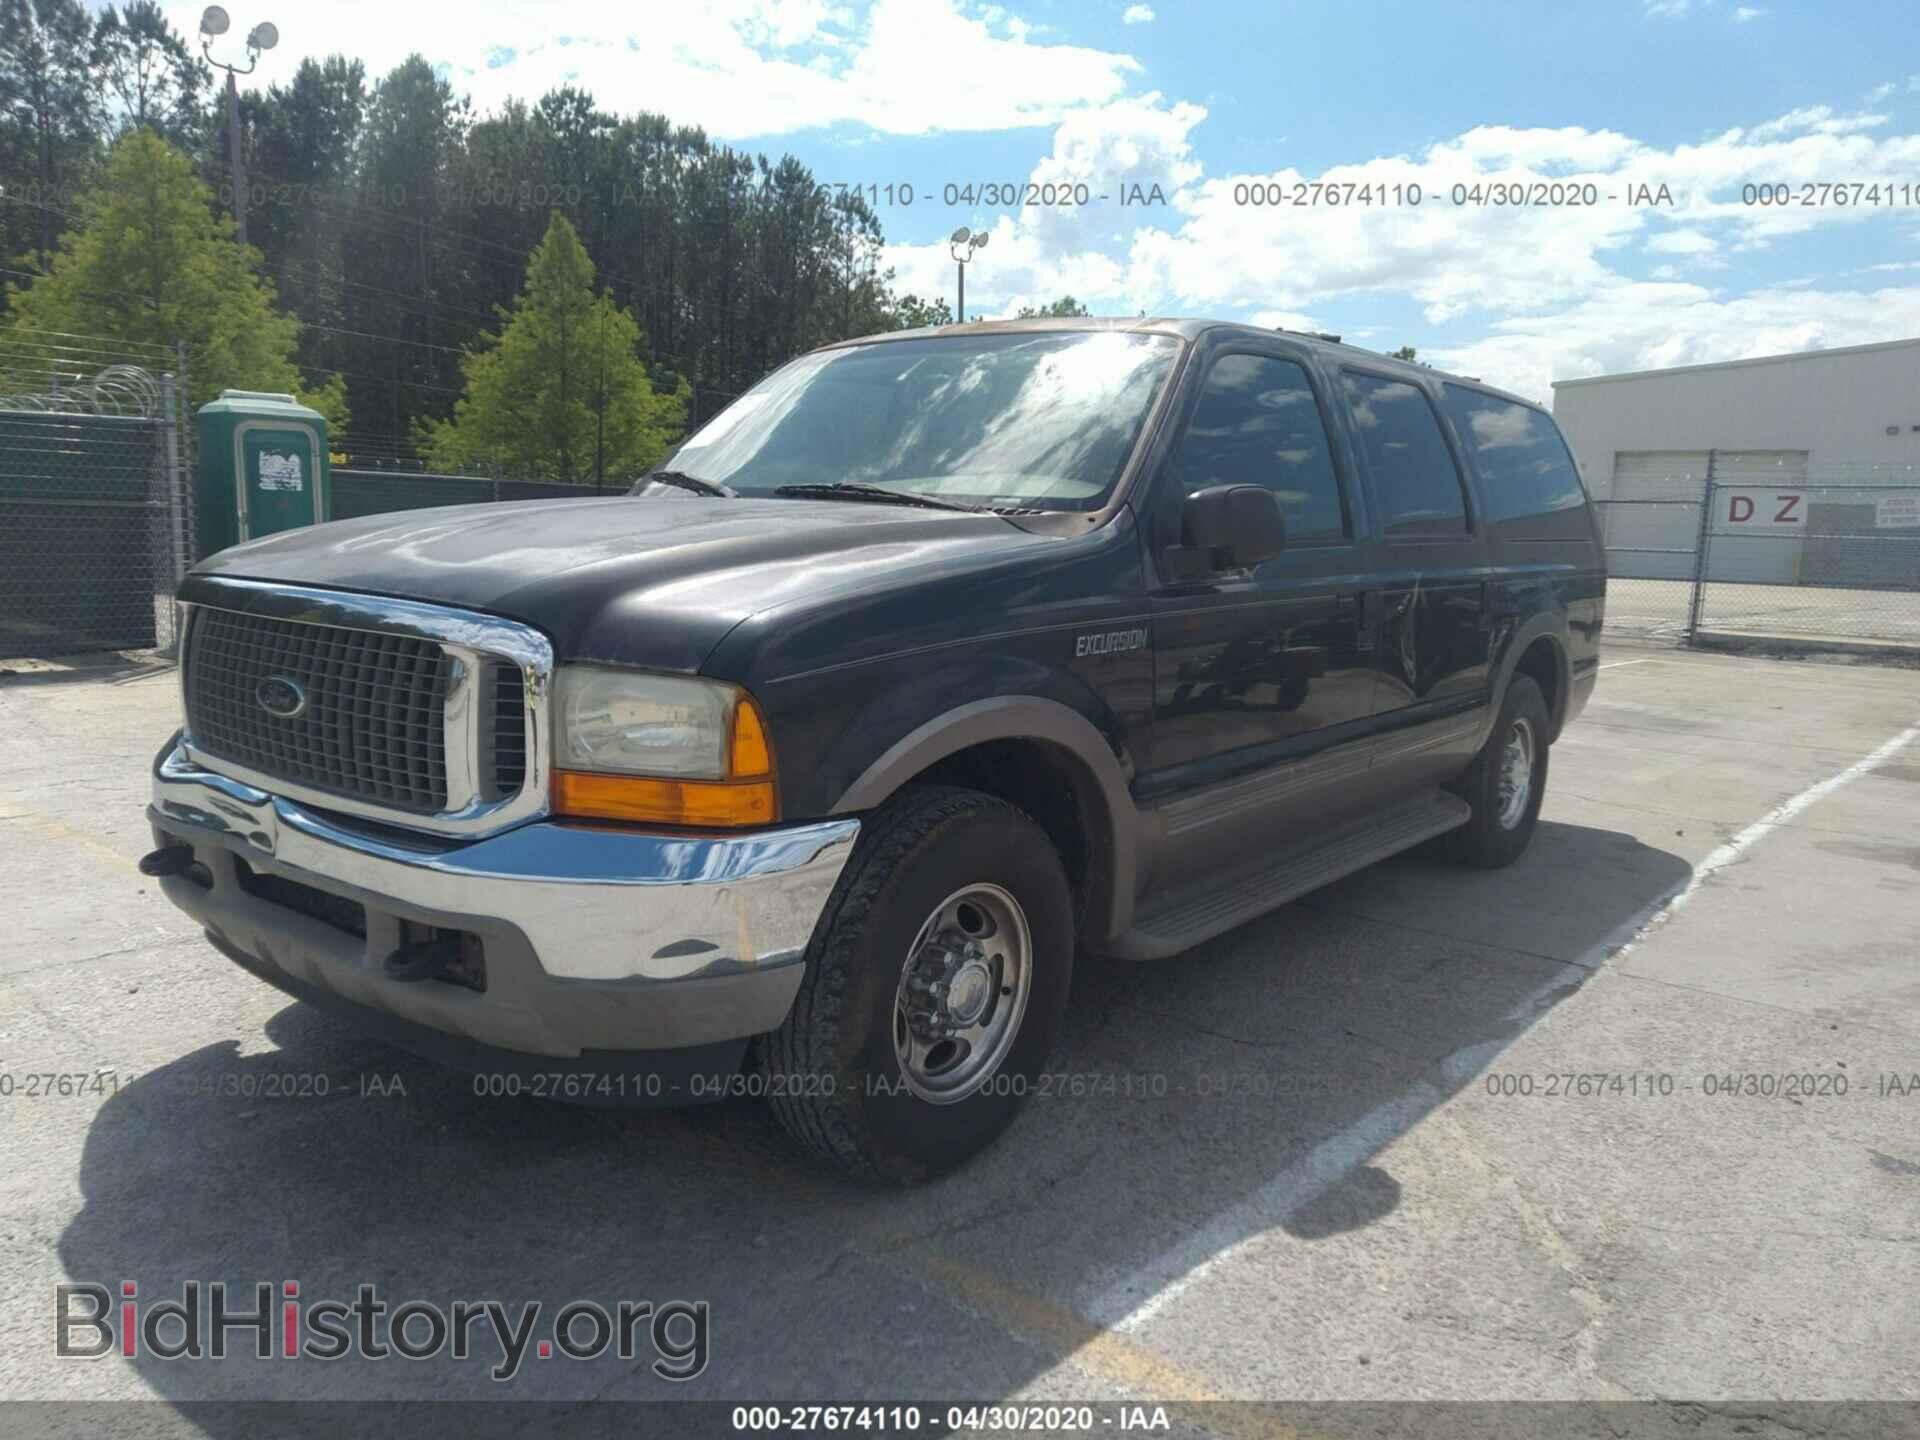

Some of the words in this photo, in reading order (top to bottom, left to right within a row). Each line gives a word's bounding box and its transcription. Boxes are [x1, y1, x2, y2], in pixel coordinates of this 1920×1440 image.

[1728, 496, 1755, 522] D
[1773, 495, 1801, 522] Z
[1076, 627, 1148, 656] EXCURSION
